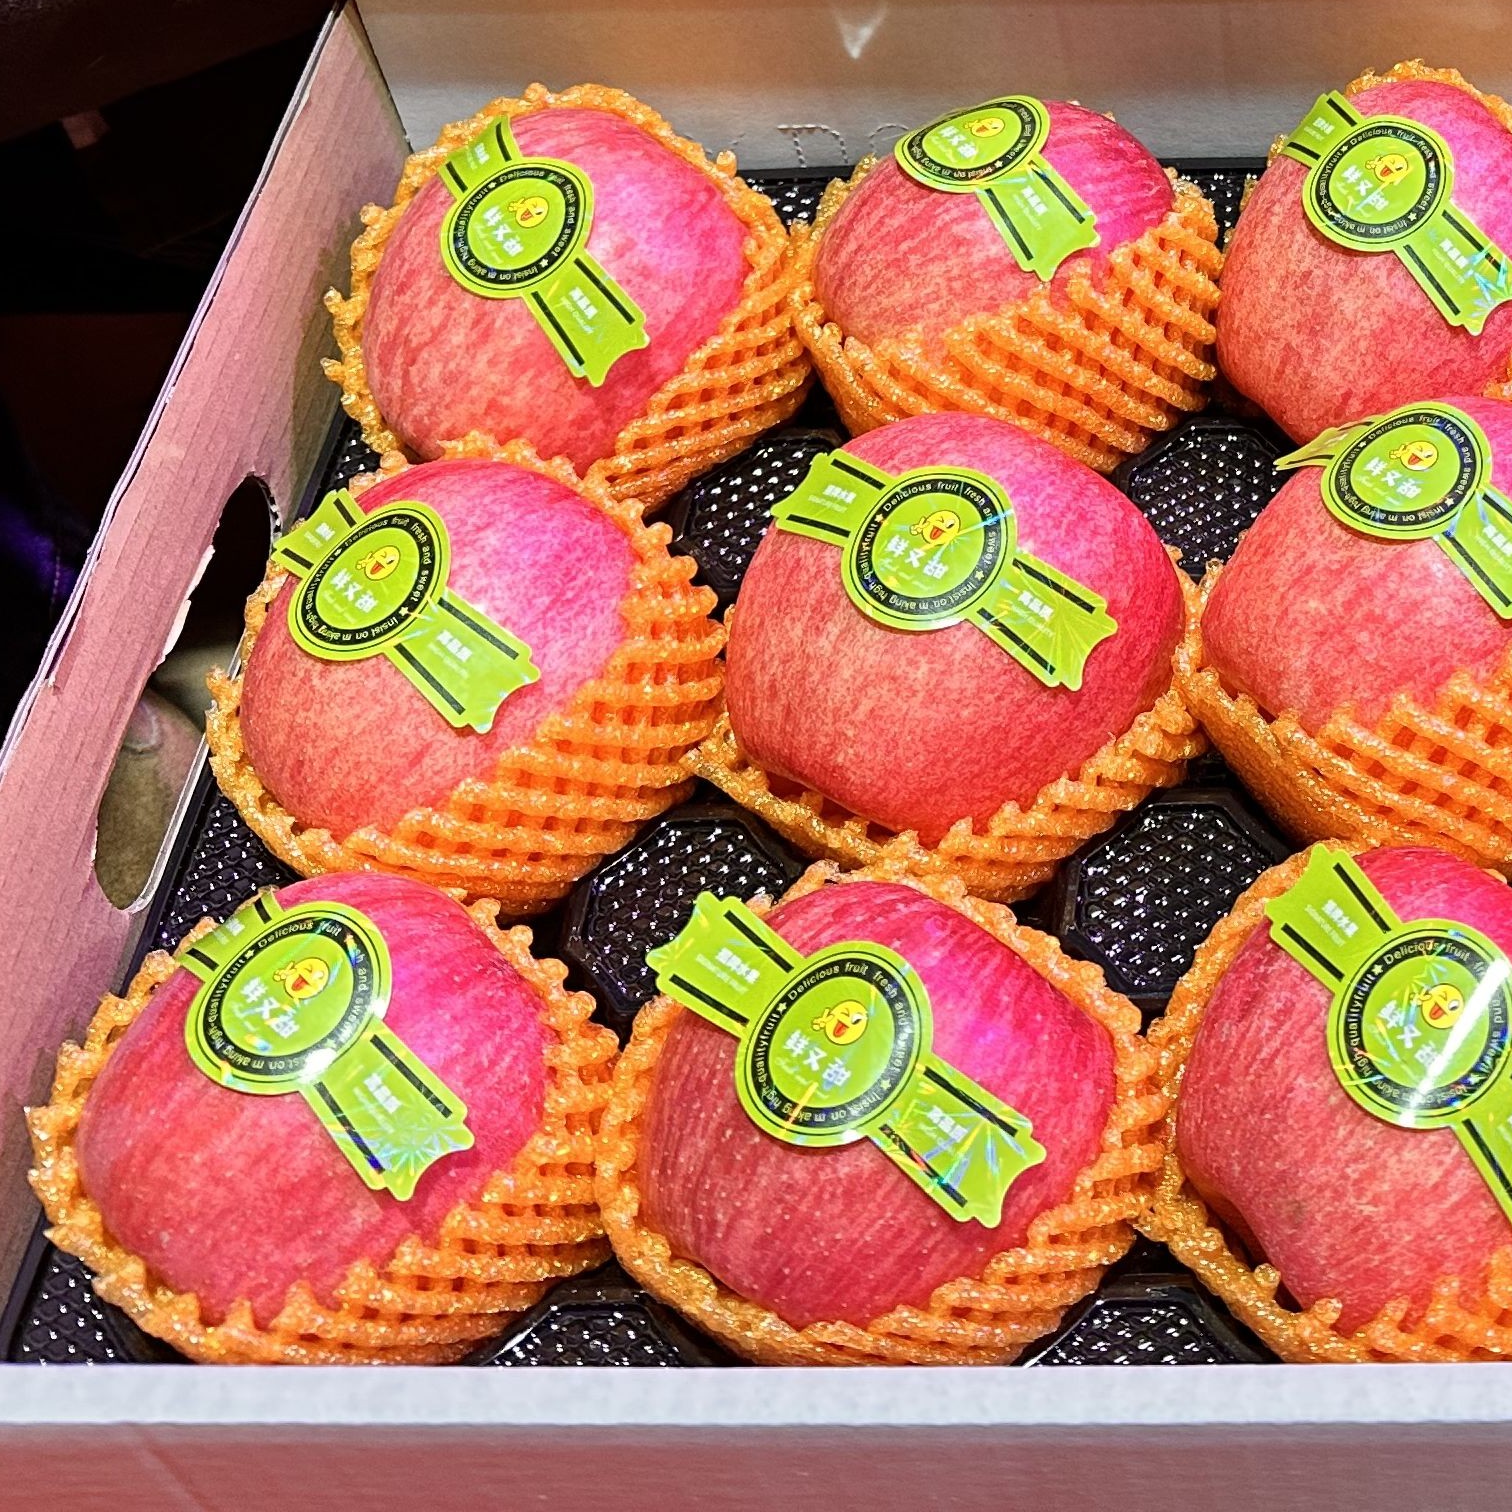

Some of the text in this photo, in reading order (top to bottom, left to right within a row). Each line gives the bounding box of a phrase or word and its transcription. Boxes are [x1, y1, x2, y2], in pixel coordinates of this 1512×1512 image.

[1416, 181, 1439, 212] sweet
[550, 227, 576, 259] sweet
[1441, 422, 1468, 444] fresh
[1460, 444, 1475, 464] and
[1452, 467, 1475, 496] sweet
[406, 521, 431, 545] fresh
[880, 480, 932, 513] Delicious
[935, 480, 962, 493] fruit
[960, 484, 991, 508] fresh
[981, 529, 1002, 566] sweet
[421, 541, 435, 566] and
[408, 567, 434, 604] sweet
[947, 579, 977, 605] Insist
[370, 614, 400, 640] Insist
[255, 921, 315, 949] Delicious
[782, 961, 841, 999] Delicious
[842, 960, 872, 978] fruit
[869, 967, 904, 1000] fresh
[783, 1031, 852, 1088] 鲜又甜
